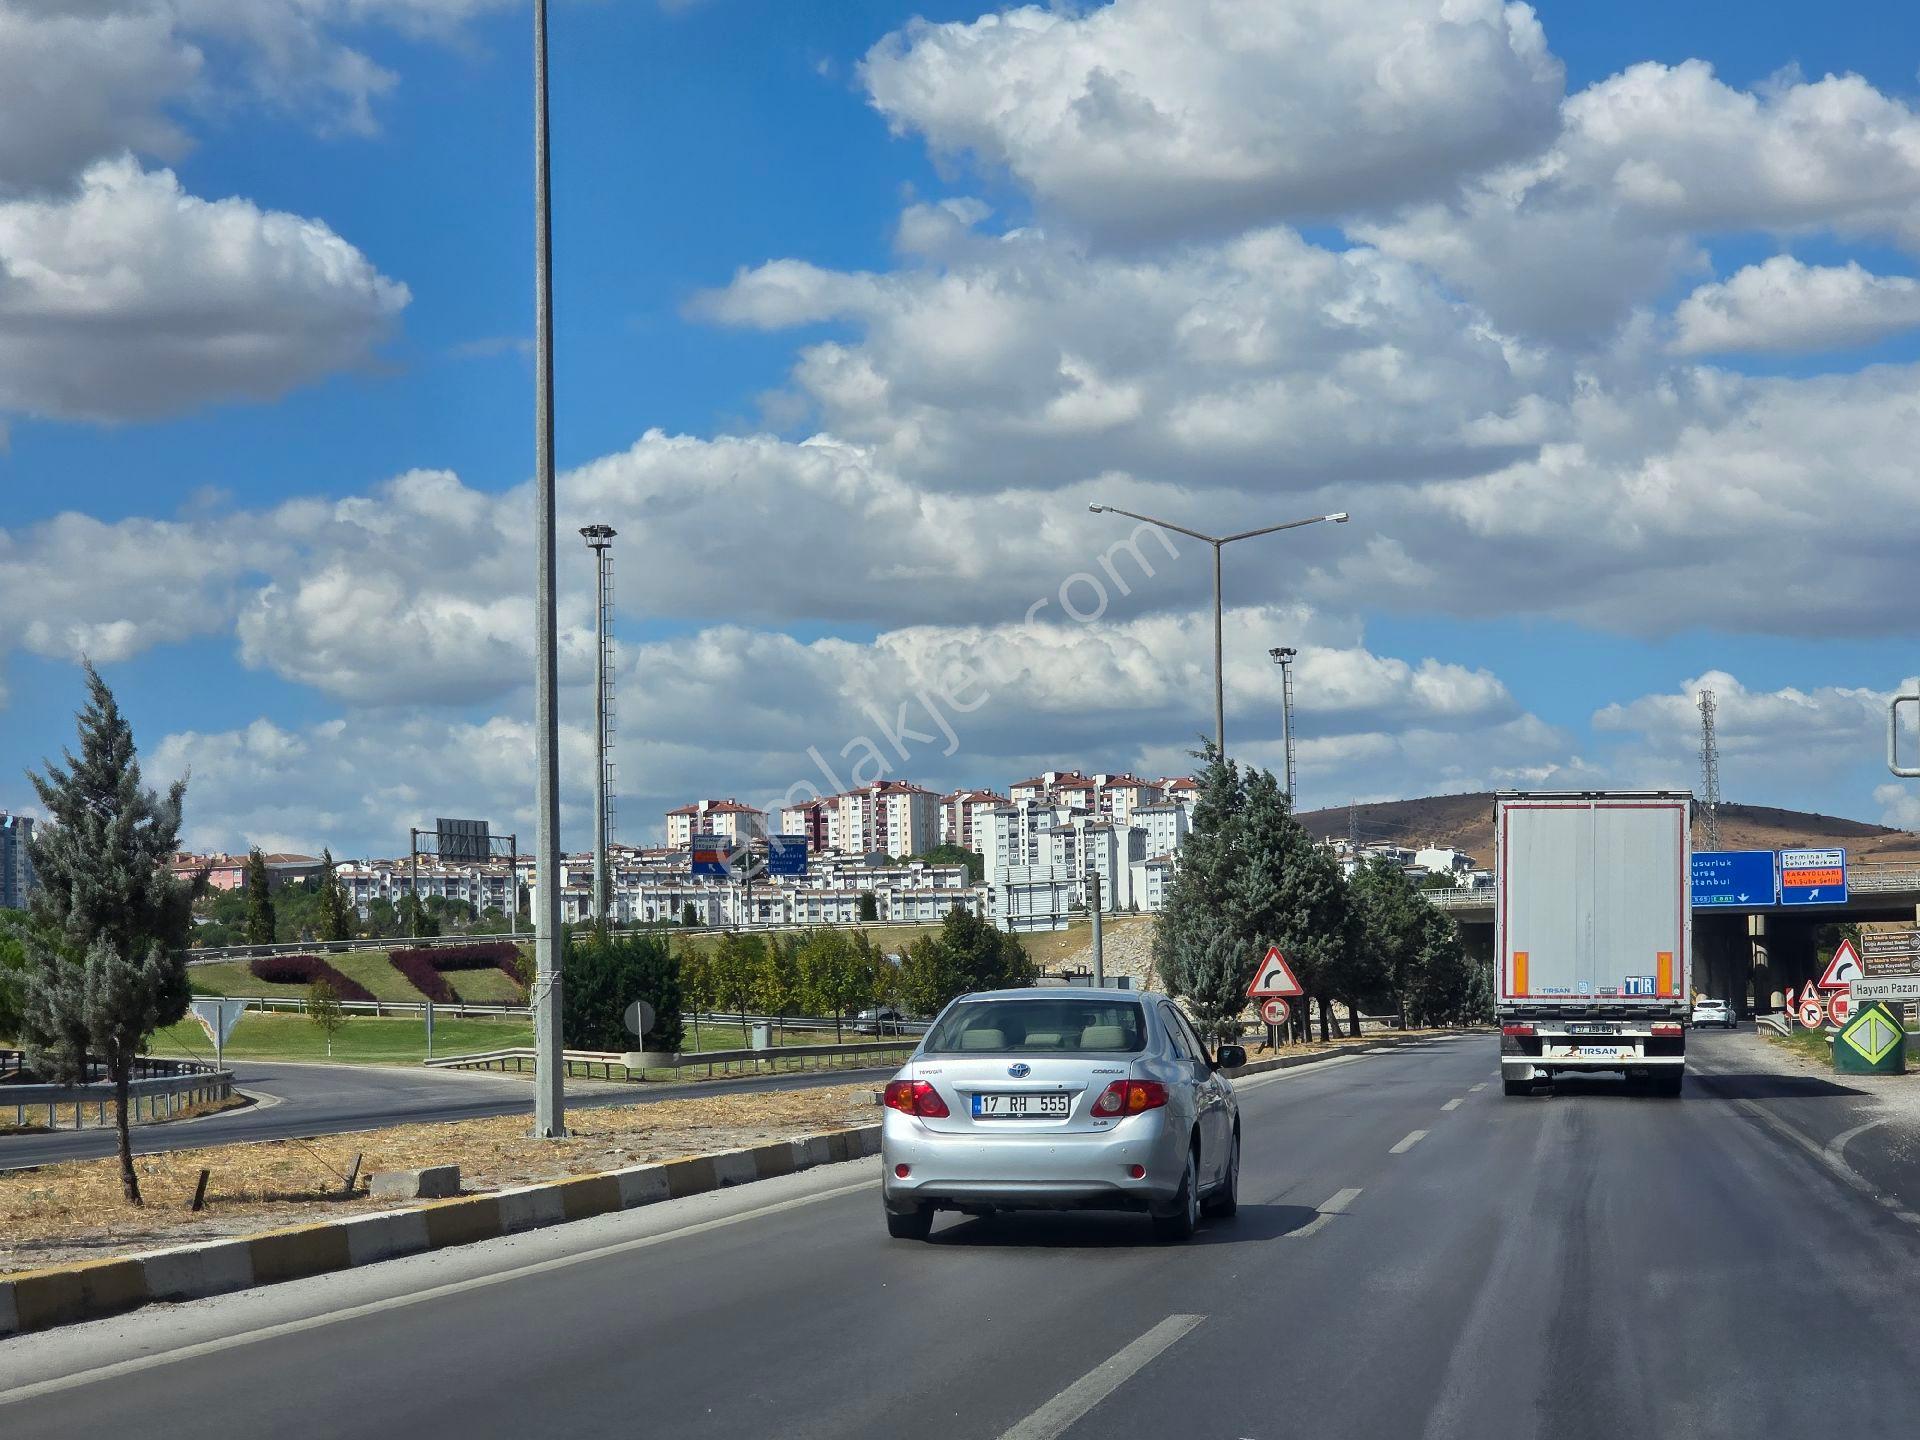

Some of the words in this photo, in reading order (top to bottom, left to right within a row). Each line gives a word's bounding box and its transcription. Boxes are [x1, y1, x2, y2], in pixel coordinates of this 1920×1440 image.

[1691, 878, 1731, 886] stanbul
[1625, 977, 1655, 994] TIR
[1856, 984, 1888, 997] Hayvan
[1891, 983, 1918, 993] Pazarı
[1578, 1047, 1618, 1055] TIRSAN
[983, 1096, 999, 1112] 17
[1010, 1096, 1027, 1112] RH
[1040, 1096, 1067, 1112] 555
